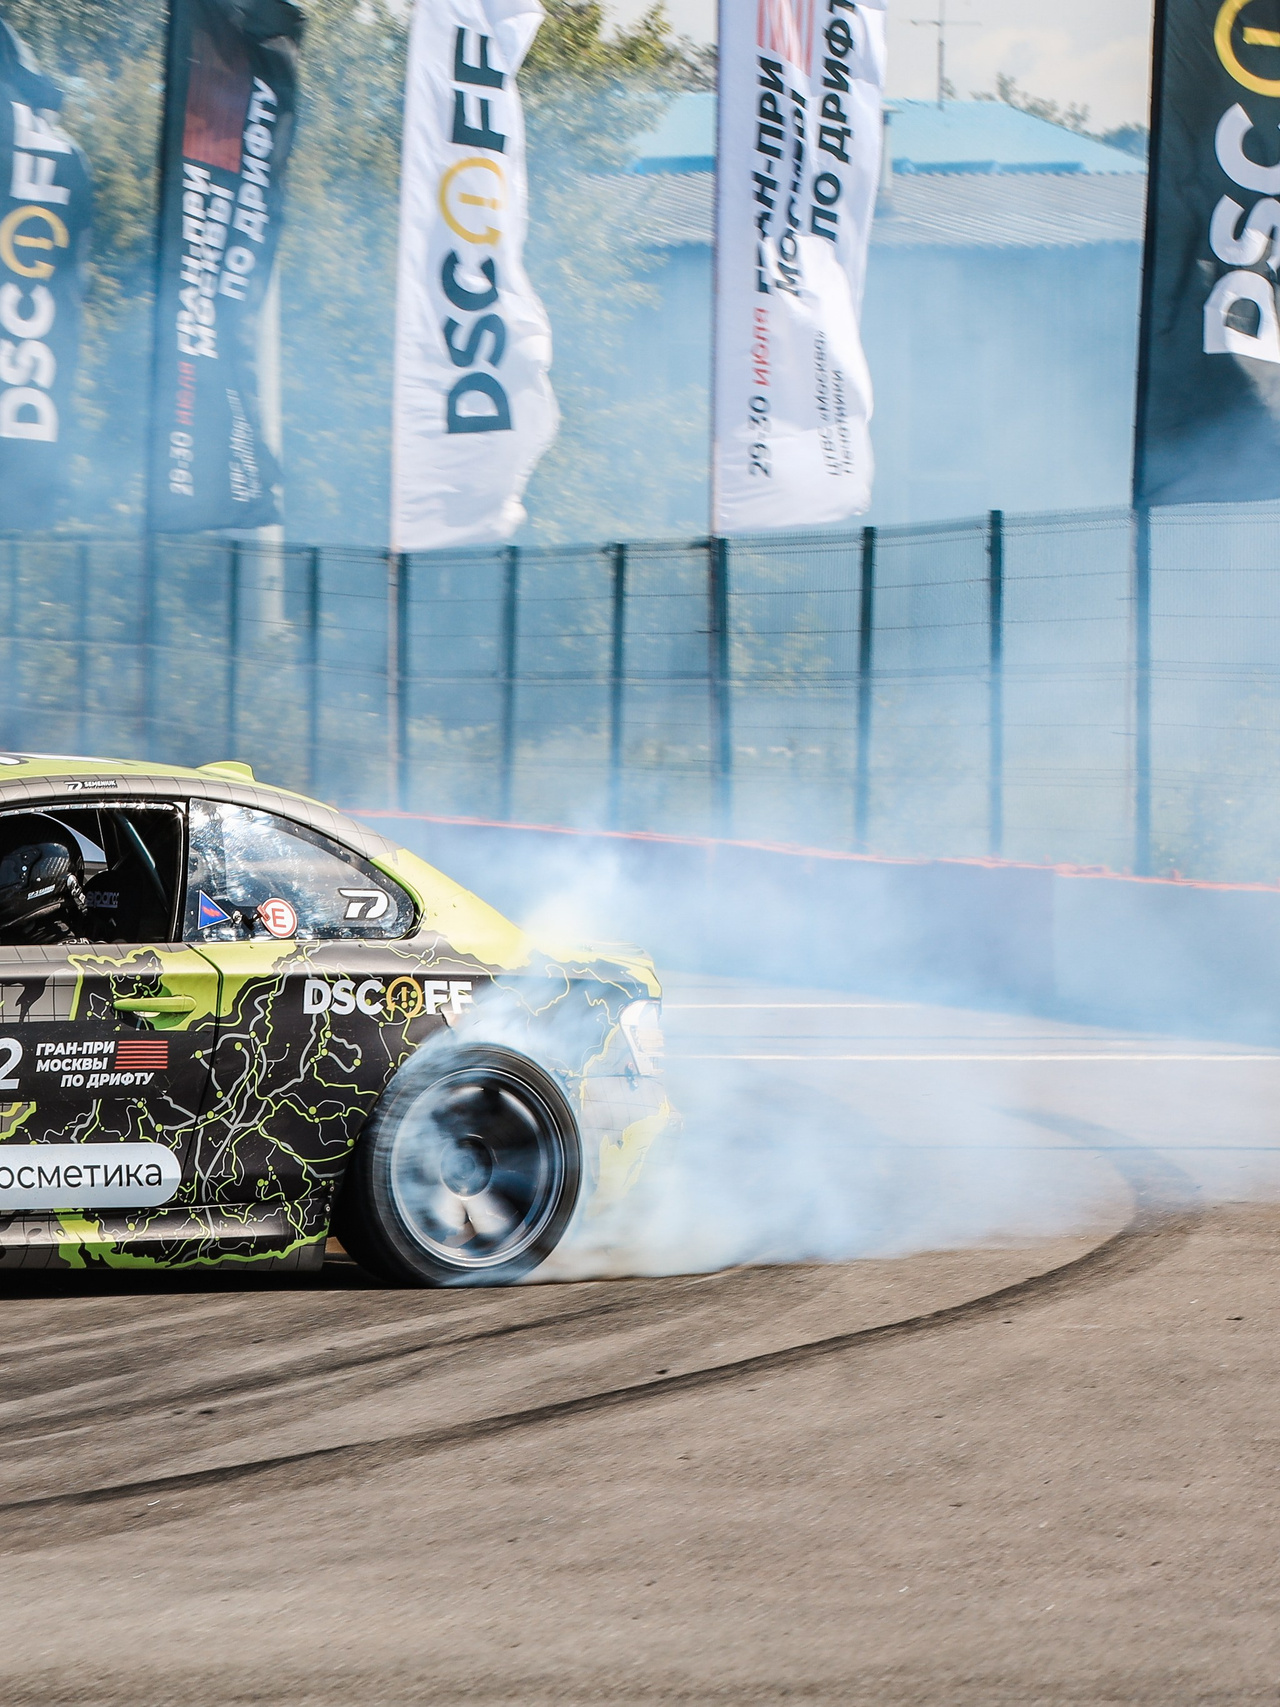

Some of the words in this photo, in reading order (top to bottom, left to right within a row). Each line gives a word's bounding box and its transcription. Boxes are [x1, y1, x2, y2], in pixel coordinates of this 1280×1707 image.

[233, 76, 279, 244] ДРИФТУ
[808, 172, 841, 243] ПО
[176, 162, 211, 356] ГРАН-ПРИ
[194, 182, 235, 359] МОСКВЫ
[219, 245, 257, 302] ПО
[271, 907, 287, 928] E
[35, 1041, 116, 1056] ГРАН-ПРИ
[35, 1057, 108, 1072] МОСКВЫ
[60, 1074, 84, 1088] ПО
[86, 1072, 154, 1089] ДРИФТУ
